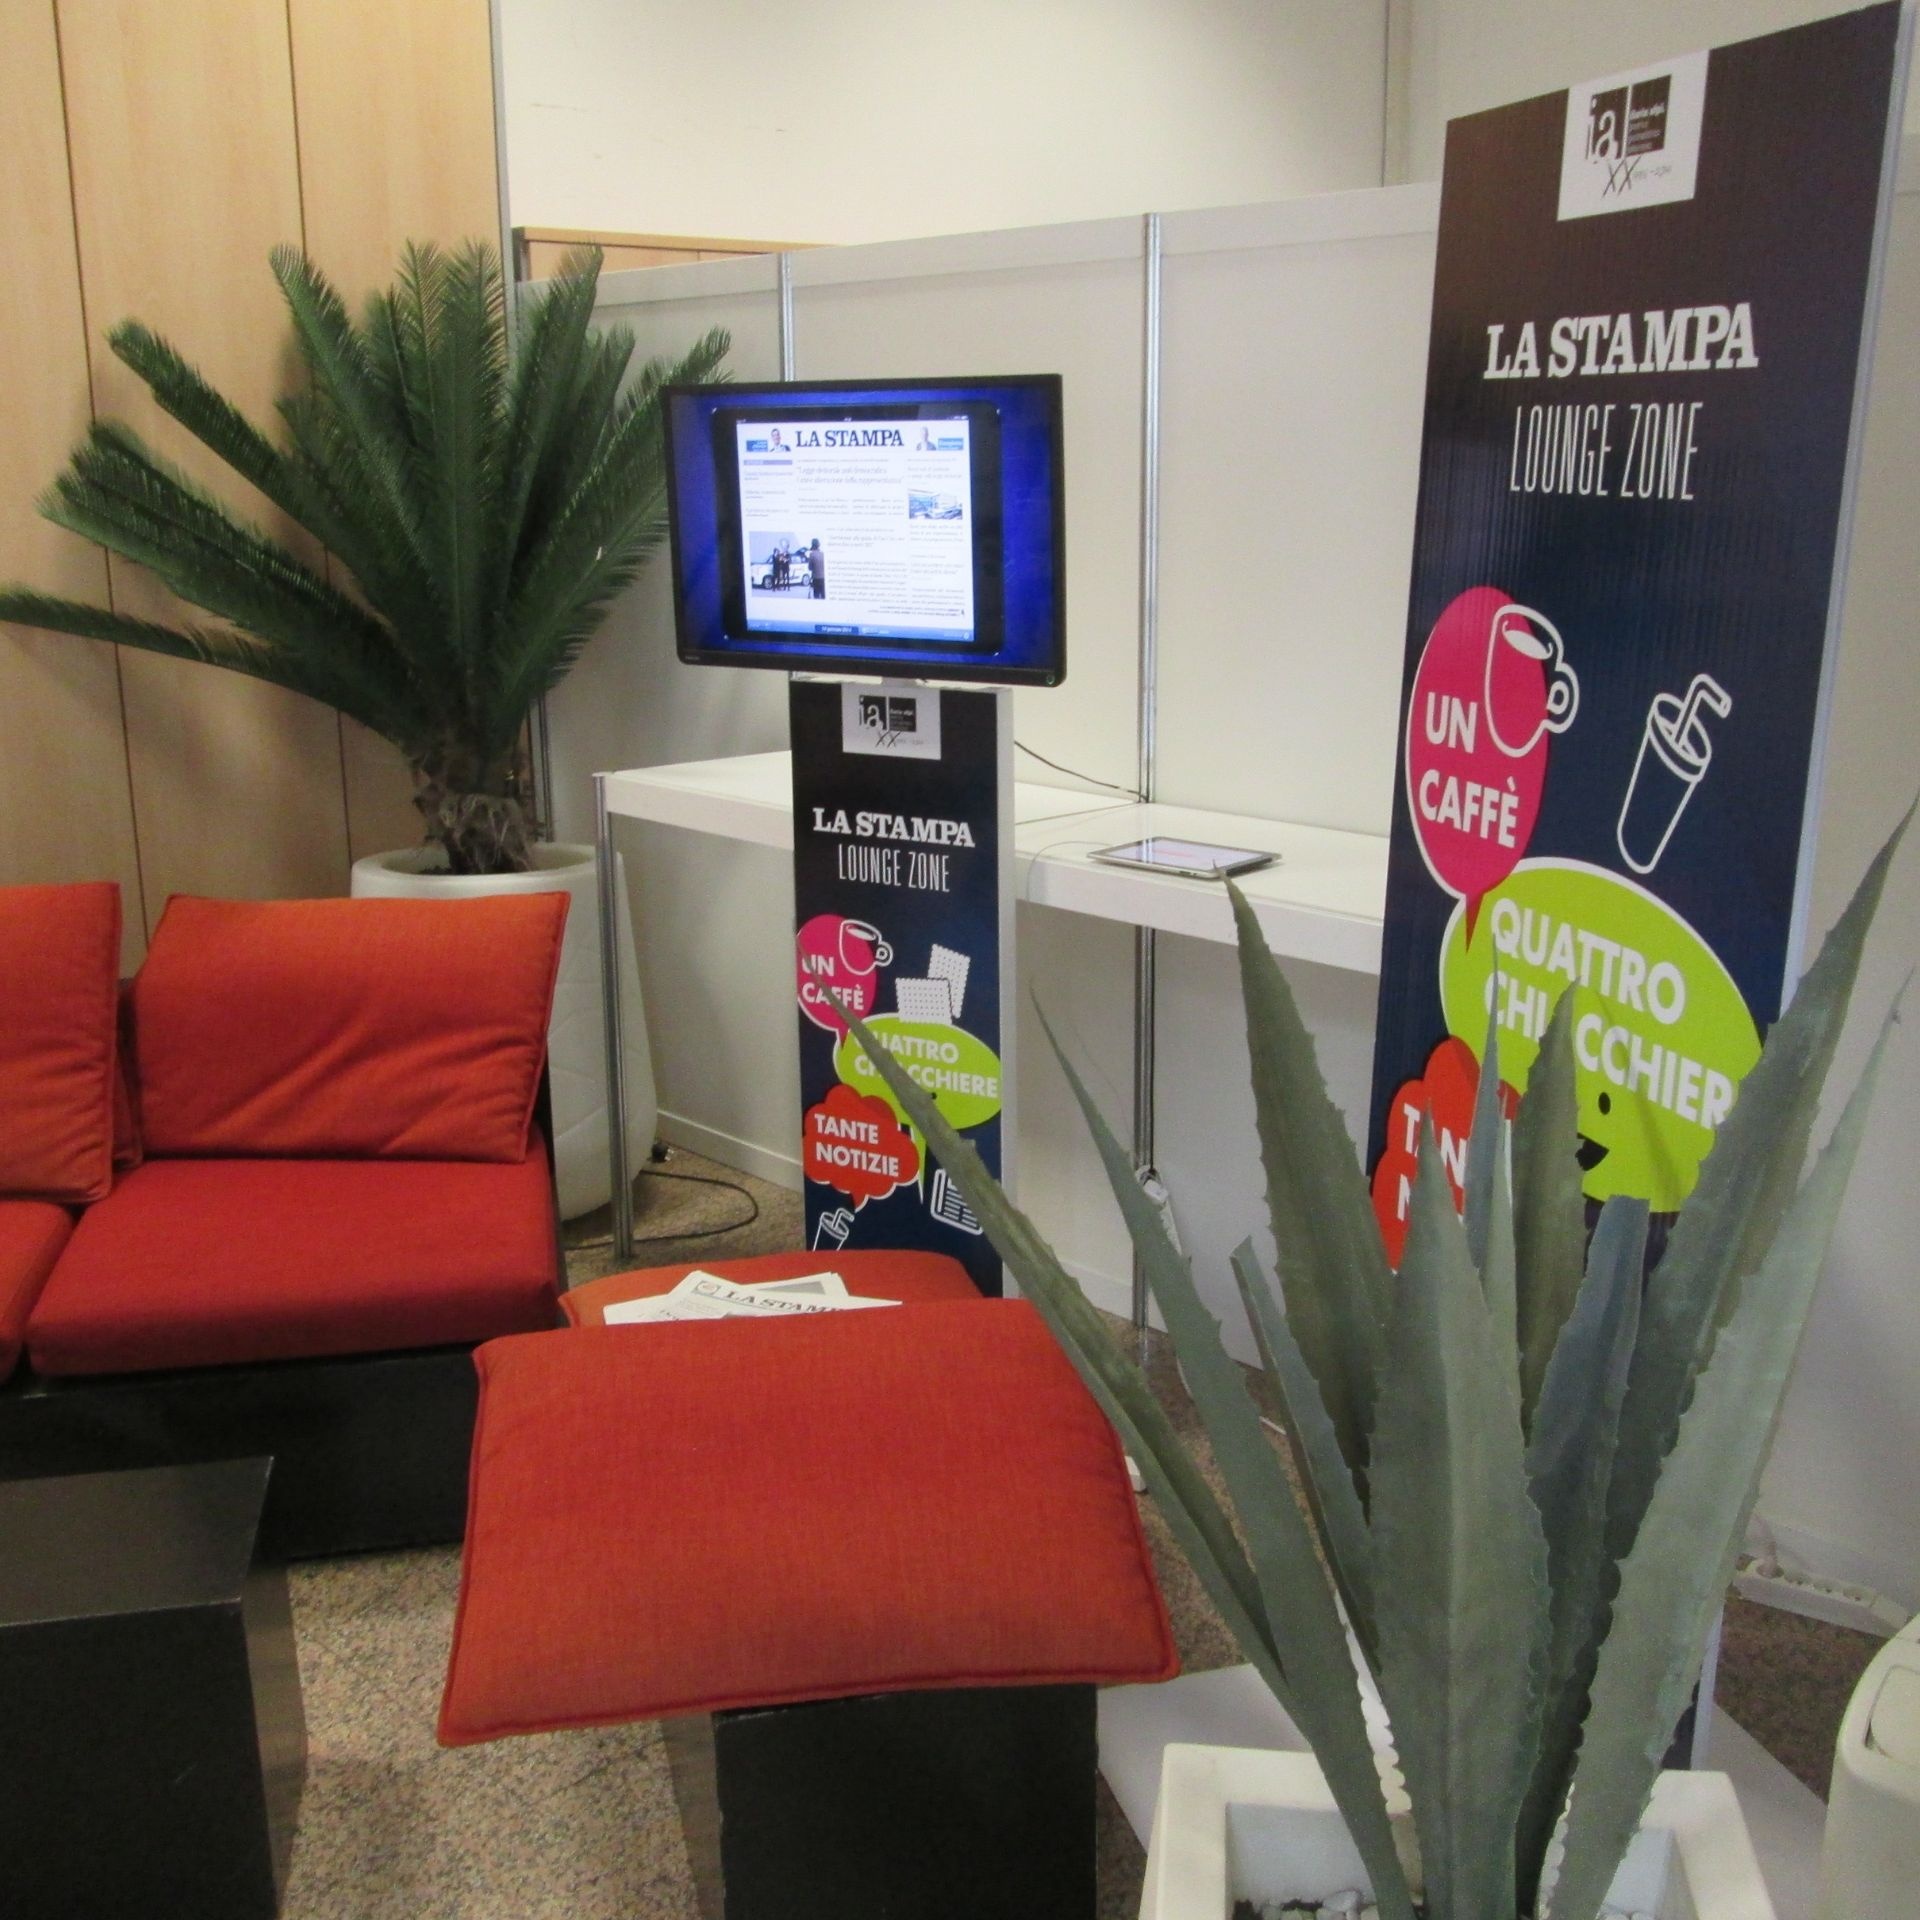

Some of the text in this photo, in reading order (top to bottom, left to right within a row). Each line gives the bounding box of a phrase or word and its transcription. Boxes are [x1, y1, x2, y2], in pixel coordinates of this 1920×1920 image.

[1483, 302, 1759, 379] LA STAMPA
[796, 429, 904, 448] LA STAMPA
[1510, 402, 1703, 500] LOUNGE ZONE
[1425, 692, 1478, 754] UN
[813, 807, 976, 848] LA STAMPA
[1419, 769, 1519, 848] CAFFÈ
[839, 844, 950, 892] LOUNGE ZONE
[802, 954, 834, 977] UN
[1491, 898, 1685, 1025] QUATTRO
[1485, 970, 1734, 1130] CHICCHIER
[814, 1113, 879, 1145] TANTE
[815, 1142, 900, 1178] NOTIZIE
[725, 1290, 756, 1304] LA
